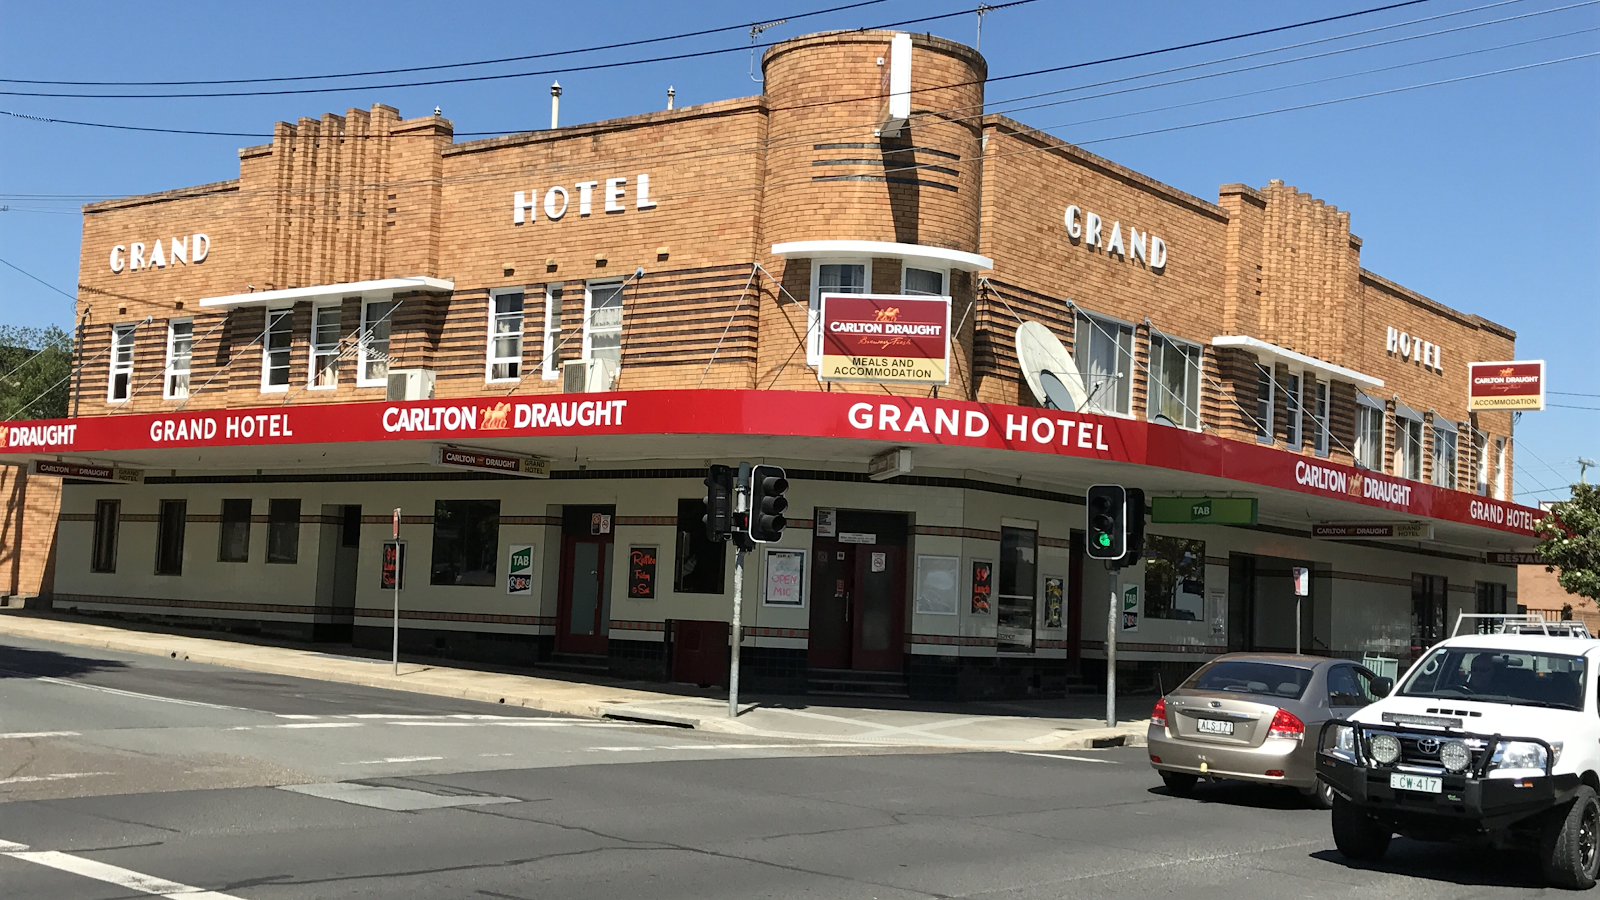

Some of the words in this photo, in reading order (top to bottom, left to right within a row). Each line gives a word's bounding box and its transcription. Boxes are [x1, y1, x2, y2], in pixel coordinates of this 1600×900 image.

[513, 173, 657, 224] HOTEL
[1064, 204, 1168, 271] GRAND
[109, 233, 211, 272] GRAND
[830, 321, 882, 333] CARLTON
[885, 323, 942, 335] DRAUGHT
[858, 336, 891, 349] Brewery
[1386, 326, 1443, 371] HOTEL
[852, 357, 888, 367] MEALS
[891, 359, 914, 367] AND
[834, 366, 931, 378] ACCOMMODATION
[382, 406, 477, 433] CARLTON
[514, 400, 627, 428] DRAUGHT
[150, 418, 217, 441] GRAND
[225, 414, 293, 438] HOTEL
[848, 402, 989, 437] GRAND
[1005, 413, 1110, 451] HOTEL
[8, 424, 77, 447] DRAUGHT
[446, 452, 476, 464] CARLTON
[485, 458, 516, 469] DRAUGHT
[524, 460, 545, 468] GRAND
[40, 464, 69, 473] CARLTON
[79, 468, 110, 477] DRAUGHT
[118, 469, 140, 477] GRAND
[524, 467, 544, 475] HOTEL
[1295, 460, 1347, 493] CARLTON
[1363, 481, 1412, 507] DRAUGHT
[1192, 506, 1210, 516] TAB
[1470, 500, 1504, 525] GRAND
[1506, 506, 1535, 531] HOTEL
[513, 555, 530, 566] TAB
[771, 574, 798, 585] OPEN
[773, 587, 791, 597] MIC
[1125, 592, 1137, 604] TAB
